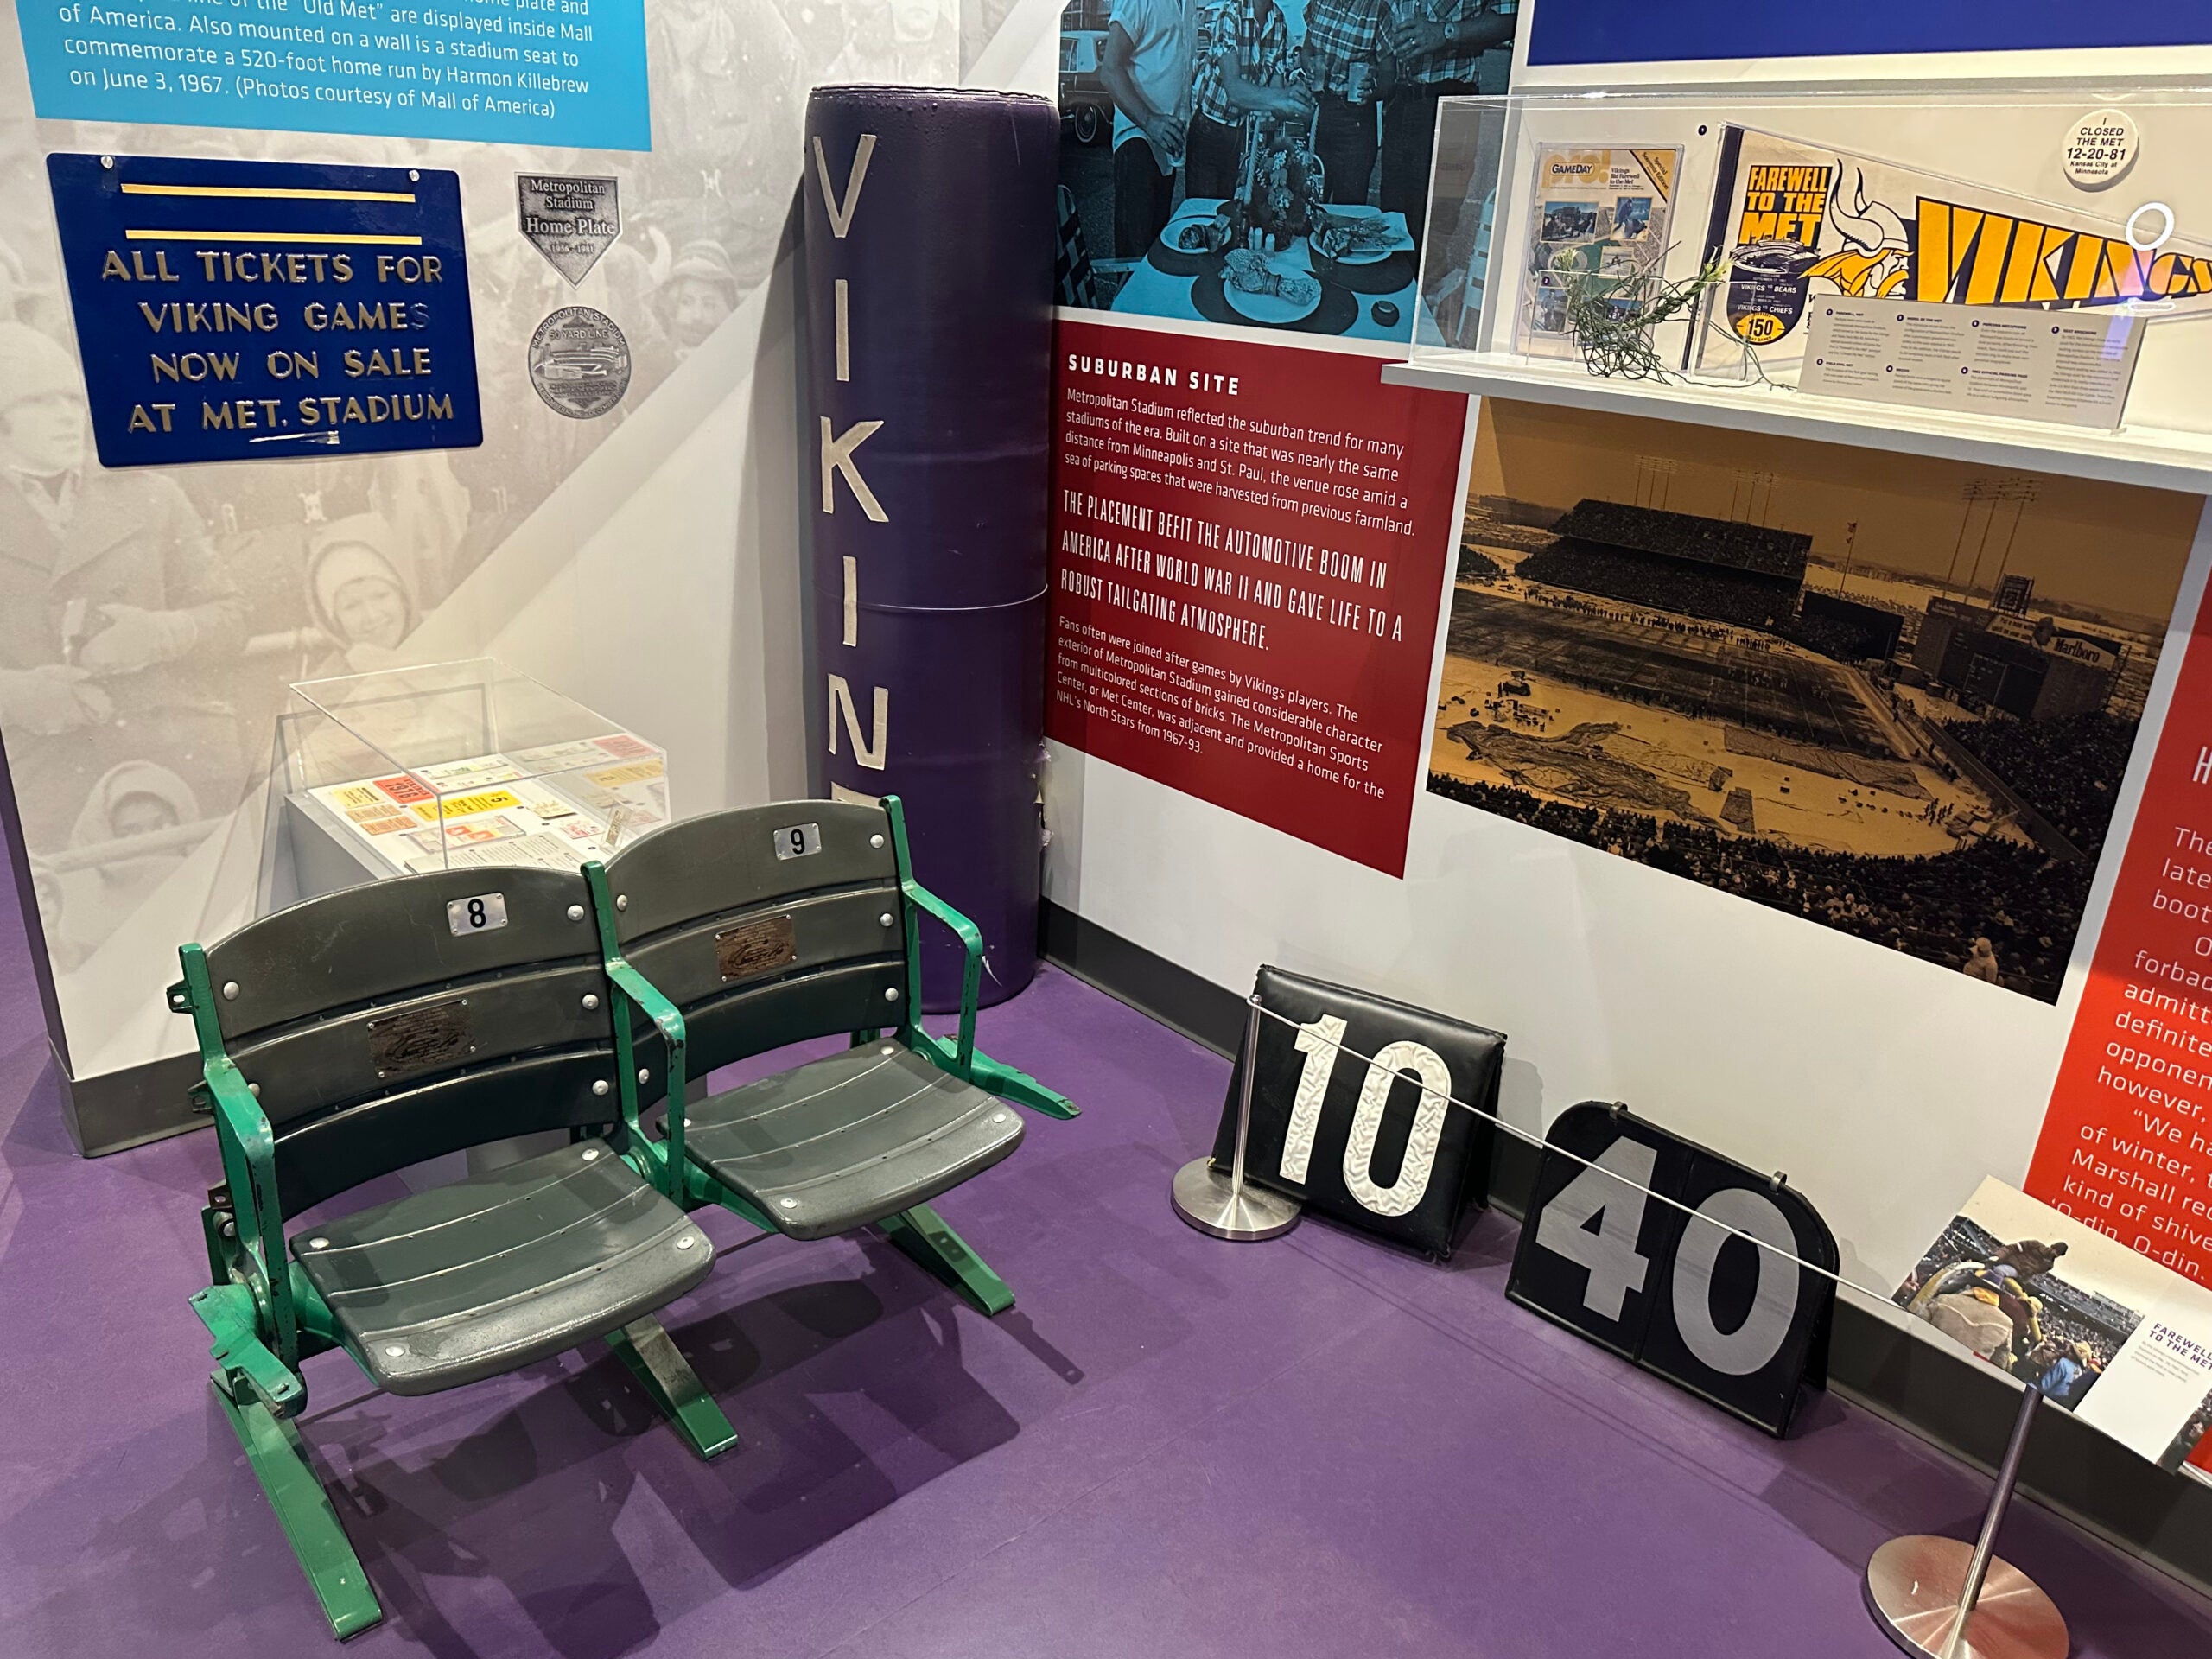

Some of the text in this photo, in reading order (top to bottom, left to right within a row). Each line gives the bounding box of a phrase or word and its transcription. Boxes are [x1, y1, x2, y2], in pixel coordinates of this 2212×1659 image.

[60, 3, 579, 67] of America. Also mounted on a wall is a stadium seat to
[391, 10, 417, 23] are
[424, 9, 502, 34] displayed
[508, 17, 555, 38] inside
[561, 23, 592, 41] Mall
[65, 39, 588, 93] commemorate a 520-foot home run by Harmon Killebrew
[70, 68, 555, 119] on June 3, 1967. (Photos courtesy of Mall of America)
[2080, 127, 2124, 136] CLOSED
[2102, 117, 2107, 125] I
[2067, 147, 2126, 160] 12-20-81
[531, 179, 606, 195] Metropolitan
[1748, 167, 1827, 192] FAREWELL
[545, 196, 594, 209] Stadium
[1746, 192, 1826, 213] TO THE
[525, 217, 615, 234] Home Plate
[1738, 213, 1822, 247] MET
[102, 250, 442, 283] ALL TICKETS FOR
[138, 302, 430, 333] VIKING GAMES
[532, 308, 626, 348] METROPOLITAN STADIUM
[563, 330, 588, 339] YARD
[1749, 318, 1773, 337] 150
[150, 348, 431, 384] NOW ON SALE
[1069, 354, 1239, 396] SUBURBAN SITE
[128, 393, 454, 434] AT MET. STADIUM
[1067, 388, 1404, 461] Metropolitan Stadium reflected the suburban trend for many
[1064, 489, 1387, 589] THE PLACEMENT BEFIT THE AUTOMOTIVE BOOM IN
[1062, 530, 1402, 642] AMERICA AFTER WORLD WAR II AND GAVE LIFE TO A
[1061, 569, 1269, 651] ROBUST TAILGATING ATMOSPHERE.
[2054, 638, 2101, 664] Marlboro
[790, 829, 805, 855] 9
[467, 898, 486, 928] 8
[2098, 1065, 2206, 1122] however,
[1278, 1014, 1452, 1217] 10
[2081, 1126, 2108, 1144] of
[2113, 1137, 2196, 1184] winter,
[2071, 1148, 2176, 1204] Marshall
[2063, 1175, 2113, 1210] kind
[2120, 1203, 2148, 1222] of
[1535, 1135, 1800, 1376] 40
[2150, 1330, 2164, 1342] TO
[2167, 1339, 2189, 1357] THE
